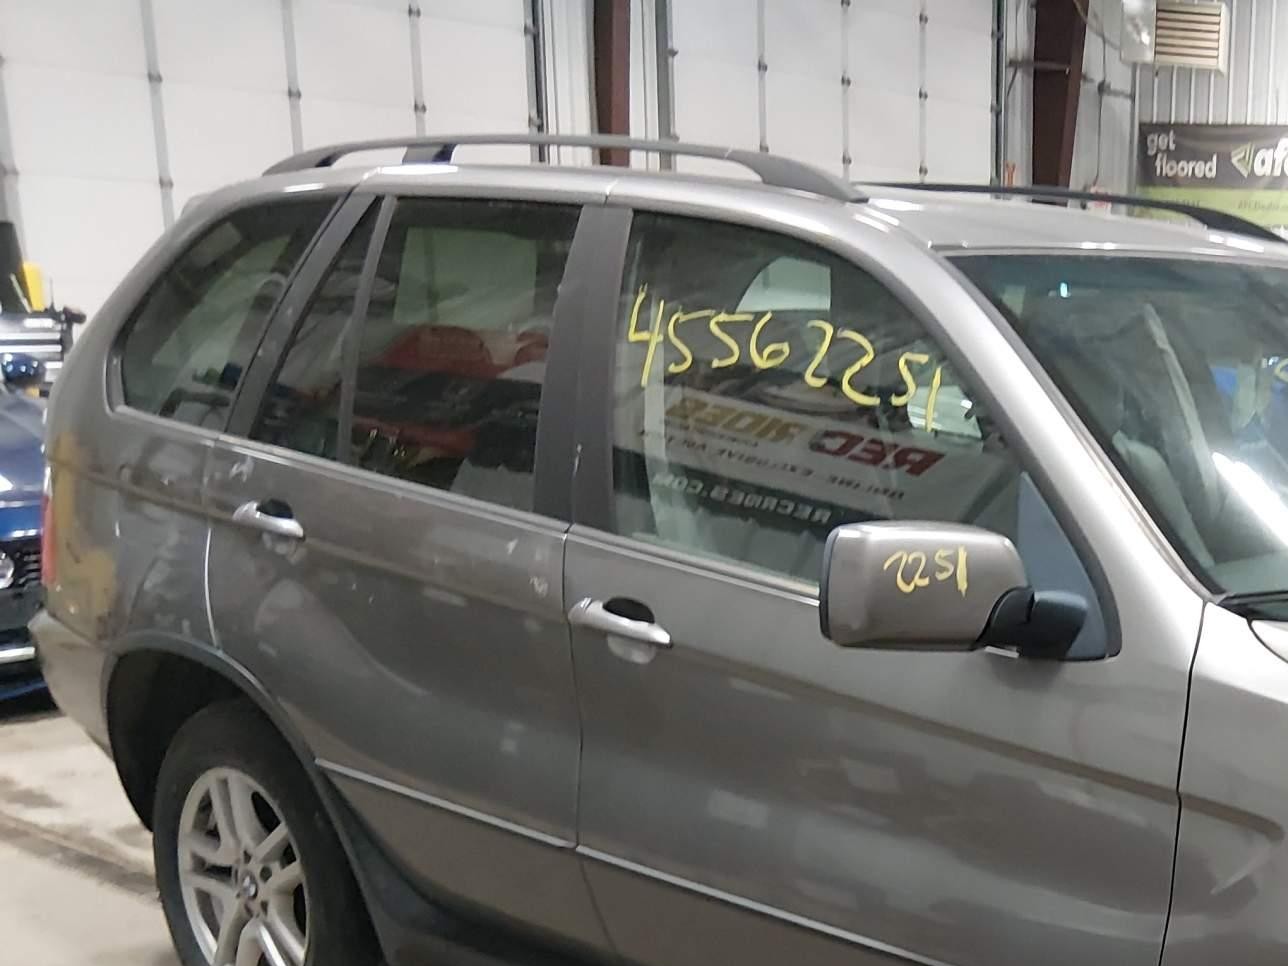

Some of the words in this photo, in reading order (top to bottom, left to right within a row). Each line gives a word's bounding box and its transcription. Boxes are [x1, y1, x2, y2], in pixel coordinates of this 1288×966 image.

[1147, 129, 1176, 155] get
[1155, 152, 1217, 178] floored
[628, 283, 942, 432] 45562251
[883, 545, 968, 598] 2251
